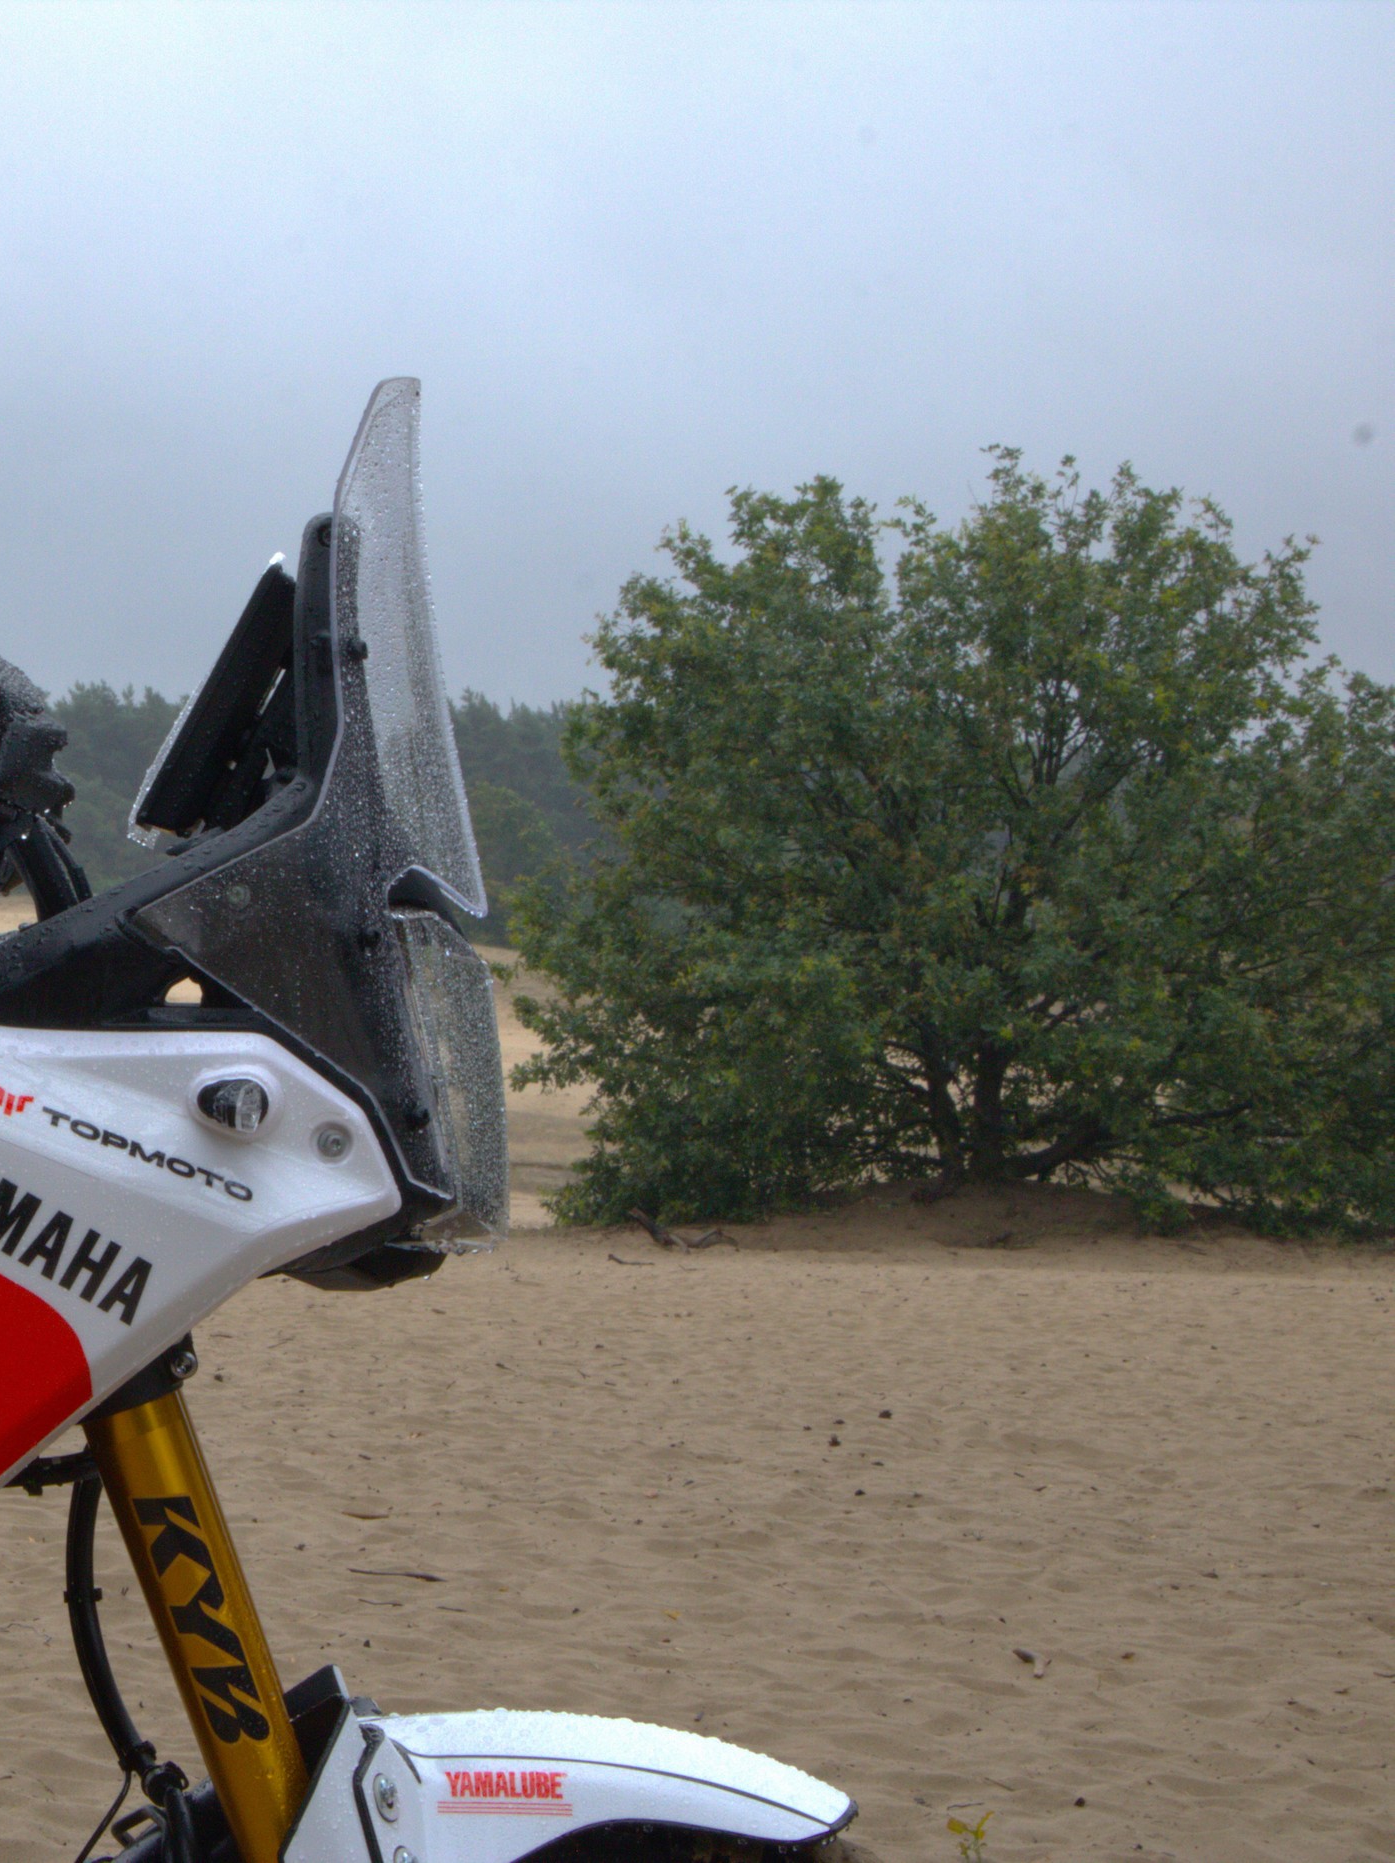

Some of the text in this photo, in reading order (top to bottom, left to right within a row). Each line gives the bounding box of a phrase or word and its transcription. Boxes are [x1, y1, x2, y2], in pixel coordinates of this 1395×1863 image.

[43, 1107, 254, 1202] TOPMOTO
[133, 1496, 269, 1744] KYB
[445, 1771, 565, 1799] YAMALUBE
